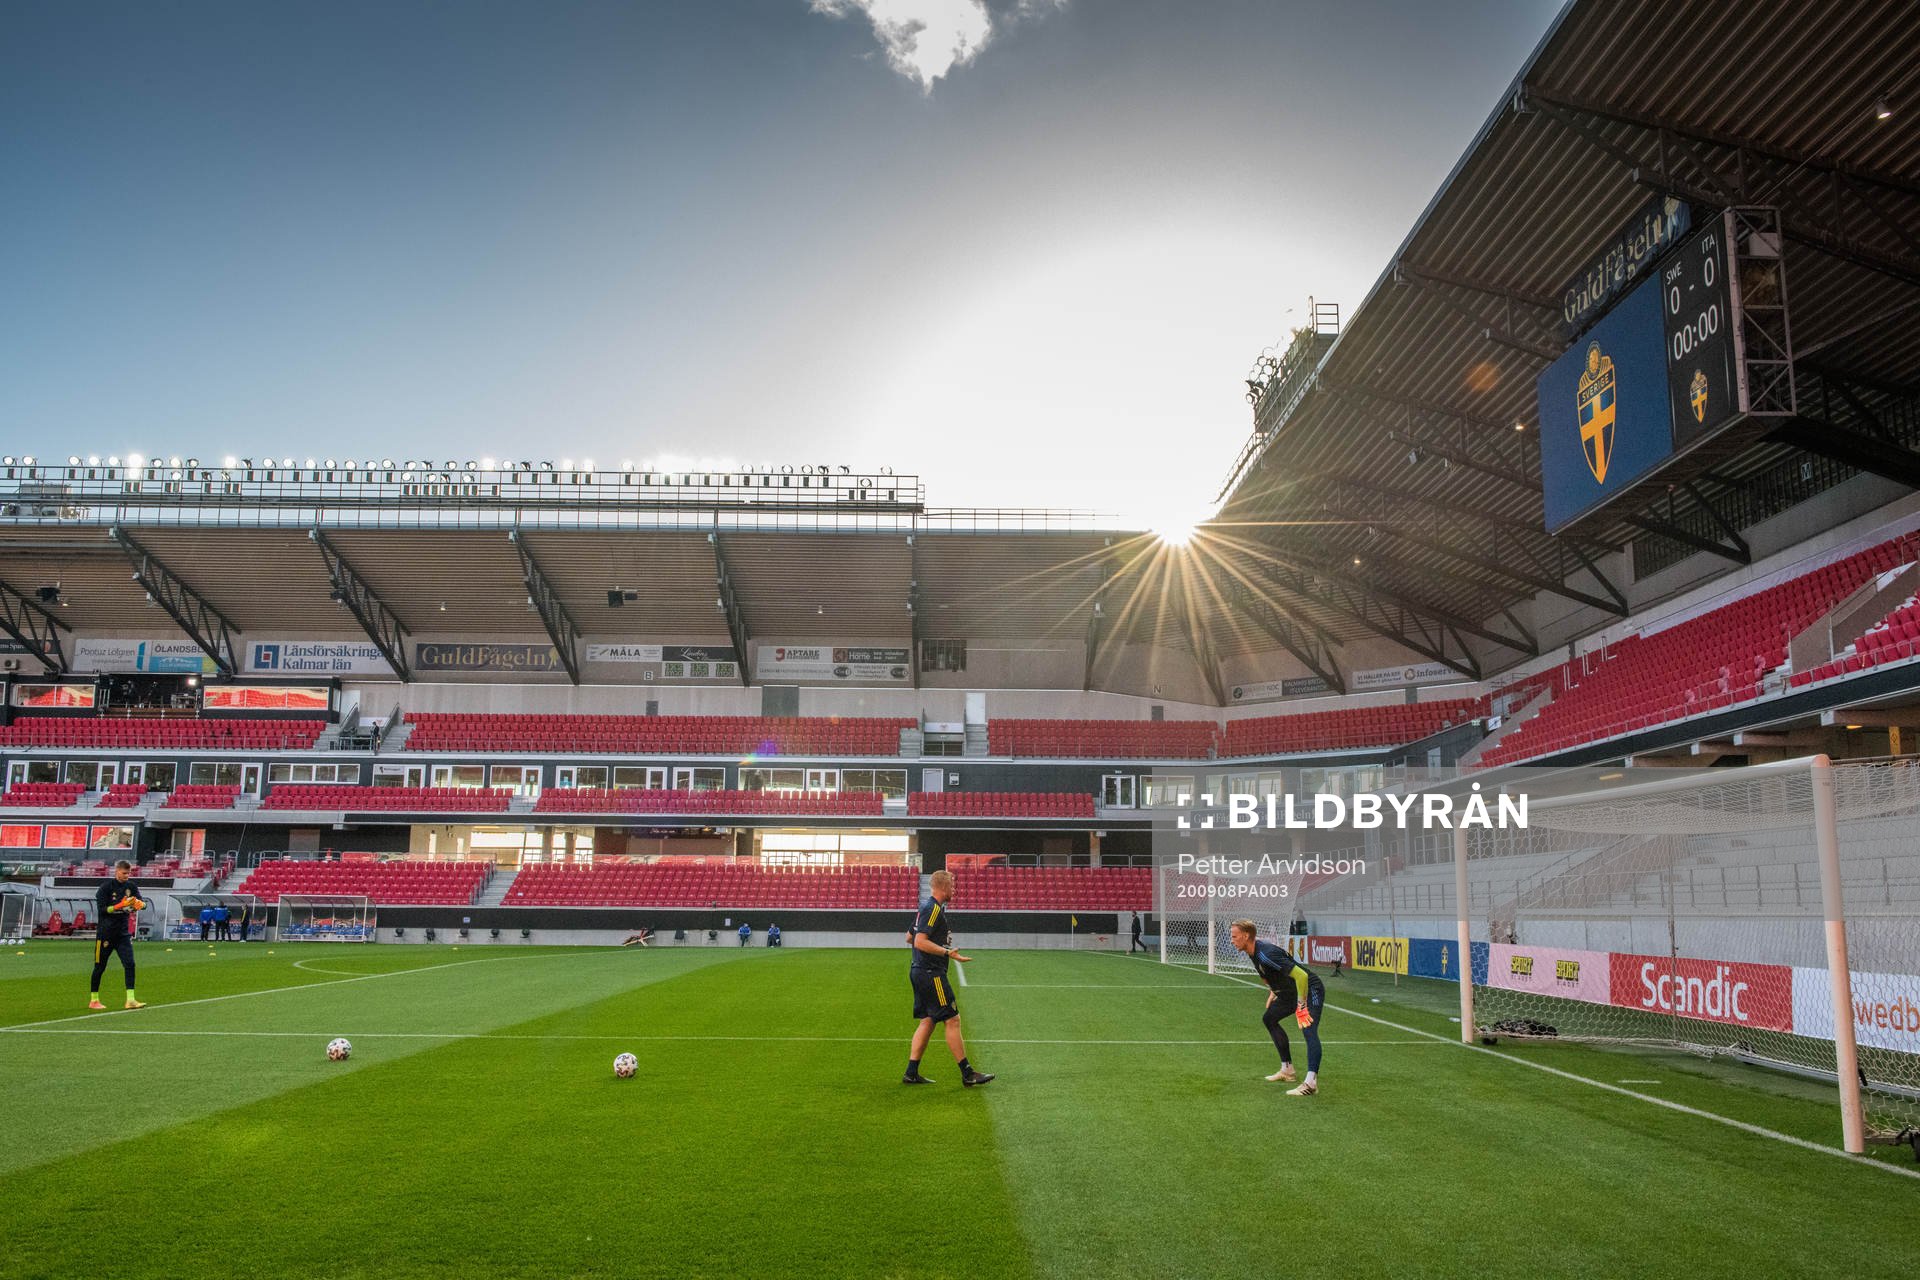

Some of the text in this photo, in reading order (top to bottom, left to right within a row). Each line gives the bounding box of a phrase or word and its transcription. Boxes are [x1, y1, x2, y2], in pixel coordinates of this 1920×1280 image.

[1702, 233, 1715, 254] ITA
[1667, 261, 1682, 285] SWE
[1671, 286, 1680, 314] 0
[1704, 257, 1714, 287] 0
[1674, 304, 1718, 360] 00:00
[154, 643, 226, 654] ÖLANDSBLT
[283, 645, 384, 660] Länsförsäkringa
[282, 658, 352, 670] Kalmar län
[1511, 955, 1533, 975] SPORT
[1556, 960, 1579, 981] SPORT
[1641, 962, 1748, 1020] Scandic
[1854, 995, 1920, 1032] wedb
